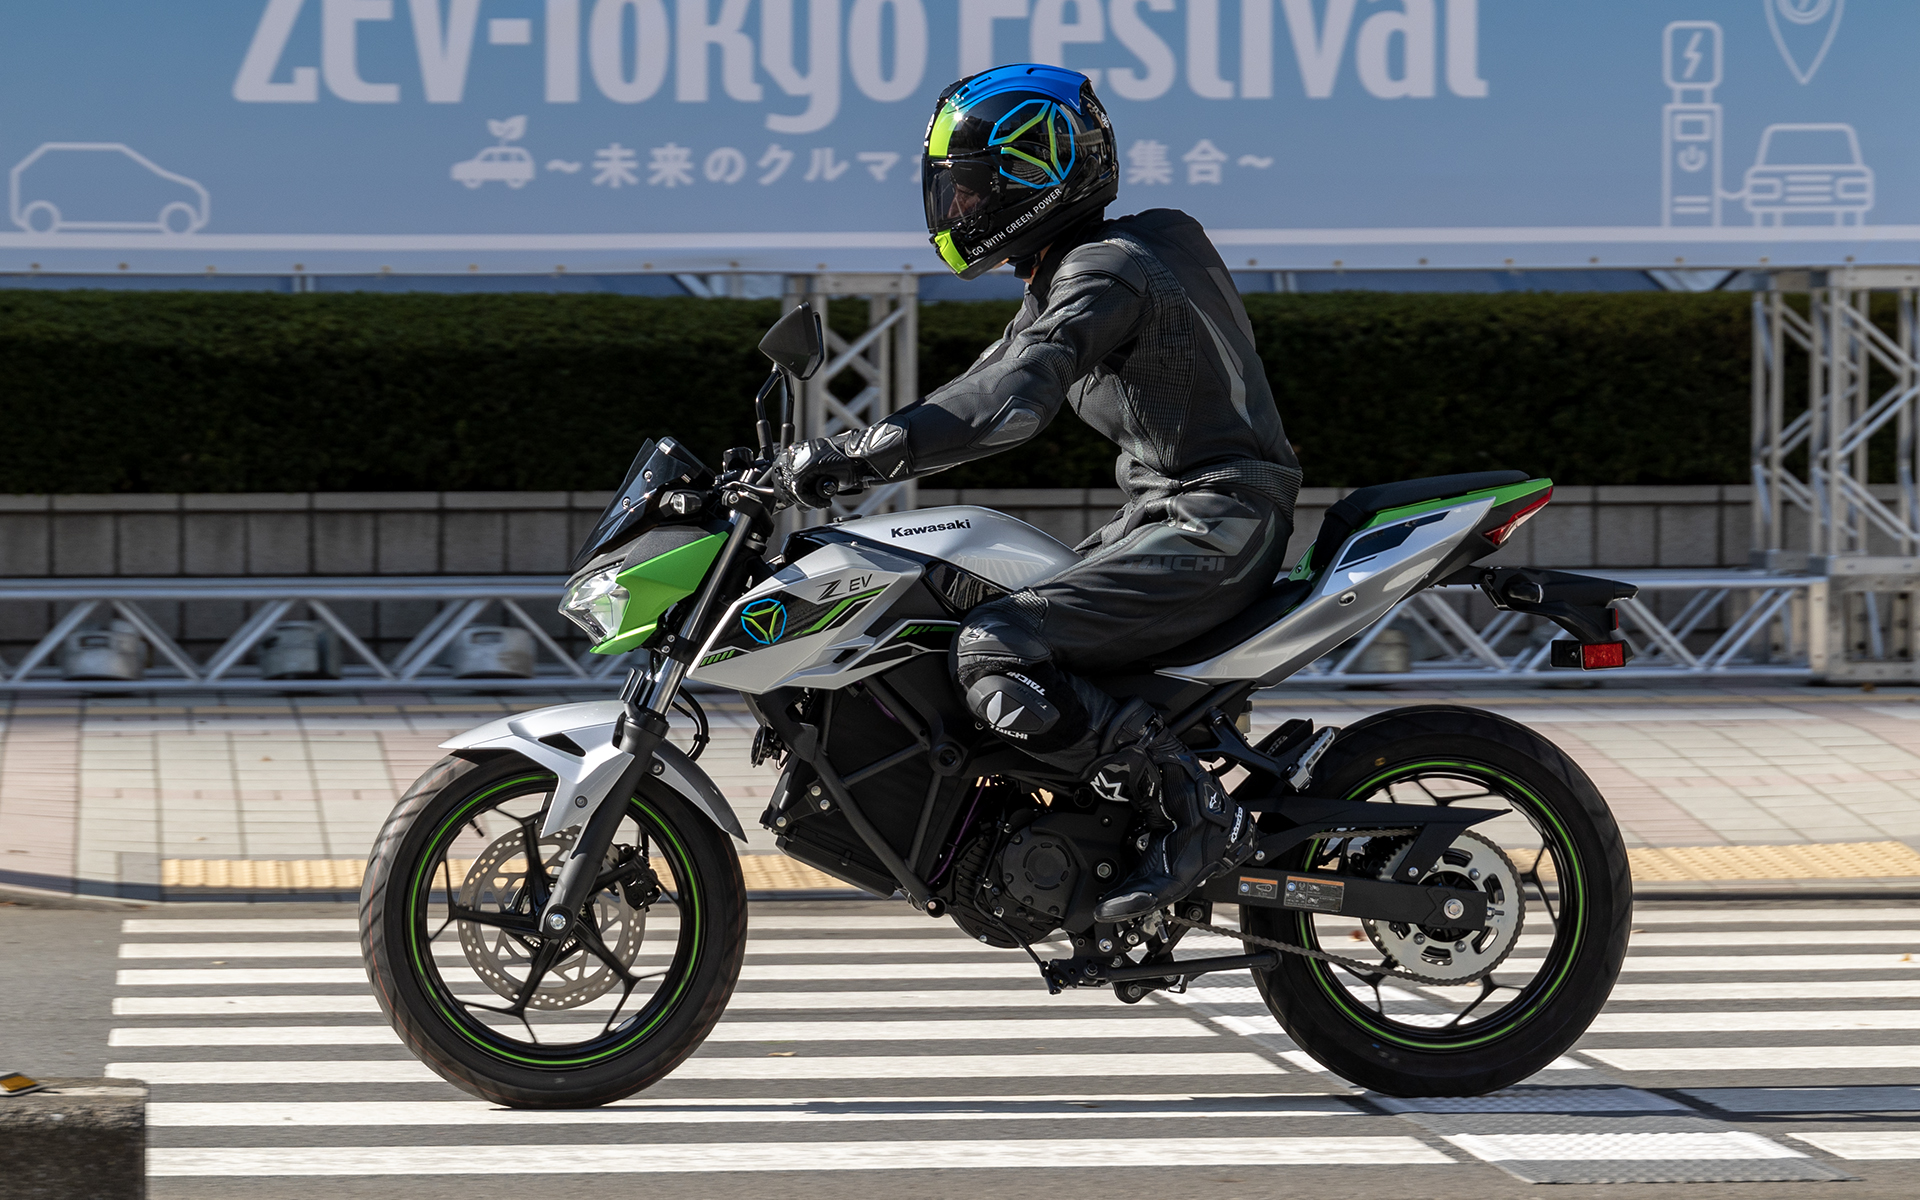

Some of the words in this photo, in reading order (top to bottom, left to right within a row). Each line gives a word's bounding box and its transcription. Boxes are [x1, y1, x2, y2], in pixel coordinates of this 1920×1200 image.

[971, 245, 984, 256] GO
[983, 231, 1006, 249] WITH
[1005, 211, 1033, 234] GREEN
[1032, 188, 1062, 214] POWER
[891, 519, 971, 538] Kawasaki
[1006, 671, 1046, 696] TAICHI
